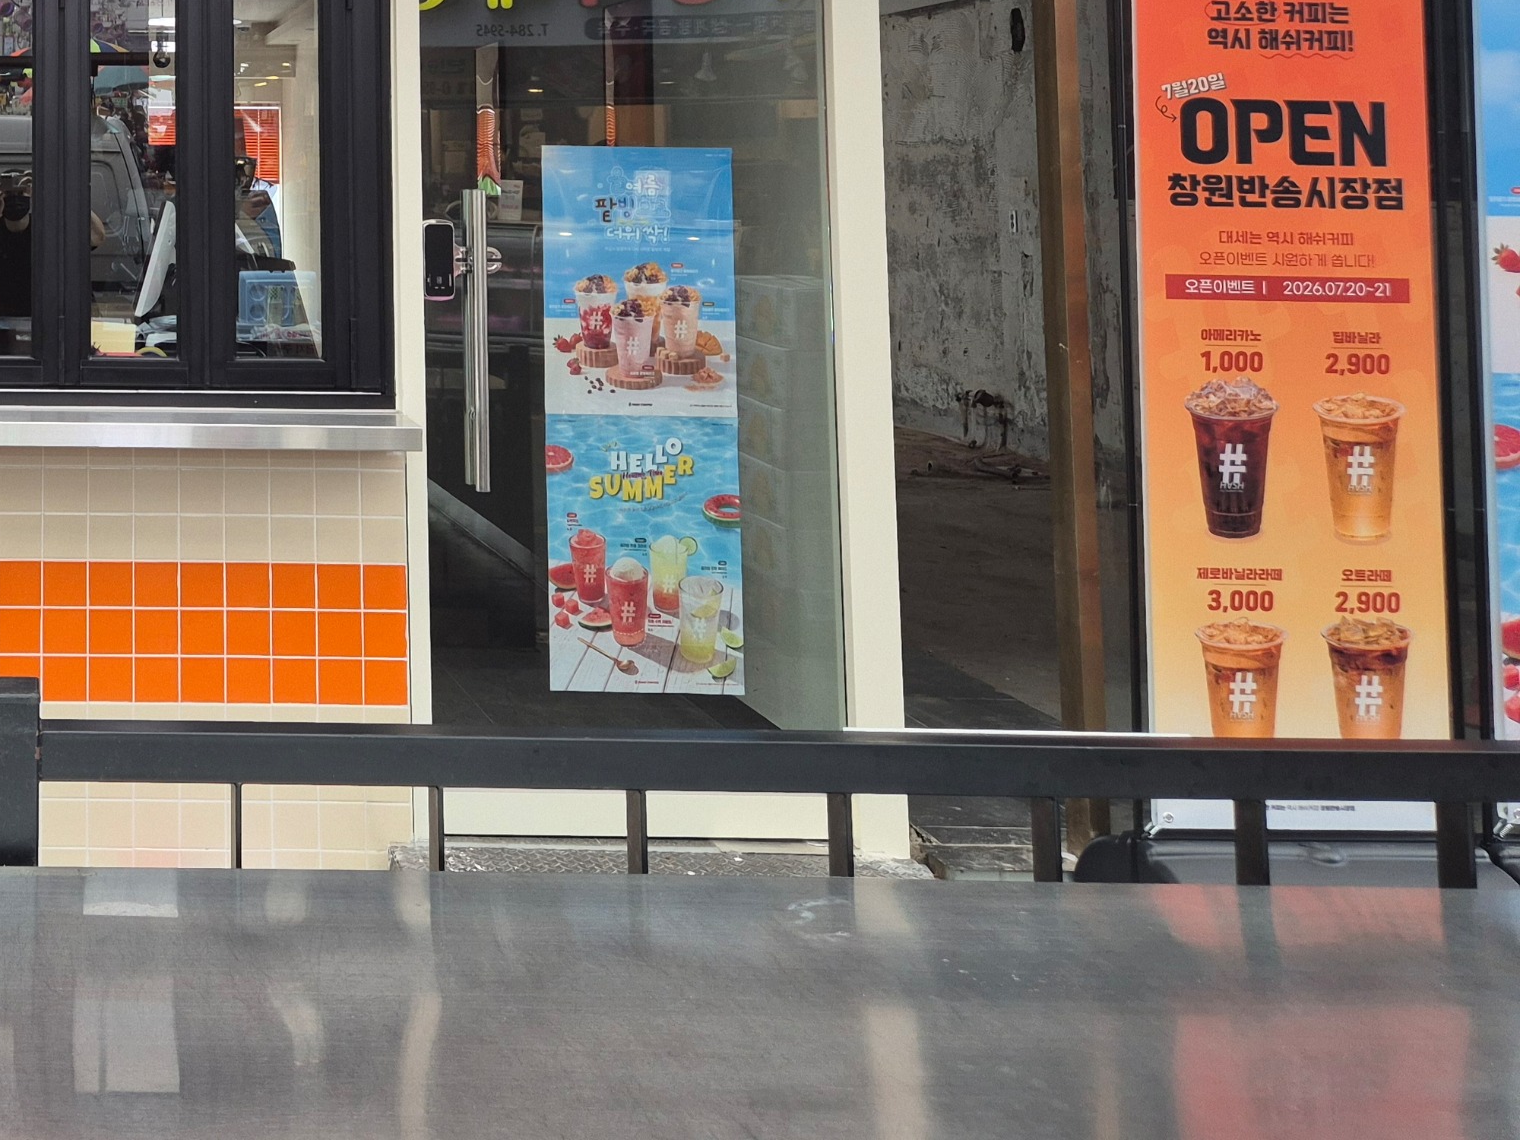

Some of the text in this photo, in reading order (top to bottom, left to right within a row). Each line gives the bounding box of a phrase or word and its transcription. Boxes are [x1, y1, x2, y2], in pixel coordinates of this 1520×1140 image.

[1210, 0, 1349, 24] 고소한 커피는
[1207, 27, 1354, 52] 역시 해쉬커피!
[1161, 72, 1226, 100] 7월20일
[1180, 97, 1387, 167] OPEN
[1167, 173, 1403, 211] 창원반송시장점
[1219, 231, 1354, 246] 대세는 역시 해쉬커피
[1199, 252, 1268, 267] 오픈이벤트
[1272, 252, 1327, 268] 시원하게
[1185, 279, 1391, 297] 오픈이벤트 2026.07.20~21
[1200, 329, 1262, 342] 아메리카노
[1200, 350, 1263, 374] 1,000
[1325, 353, 1390, 376] 2,900
[610, 437, 682, 472] HELLO
[589, 455, 694, 502] SUMMER
[1196, 567, 1283, 581] 제로바닐라라떼
[1341, 569, 1392, 582] 오트라떼
[1207, 590, 1274, 613] 3,000
[1335, 591, 1400, 615] 2,900
